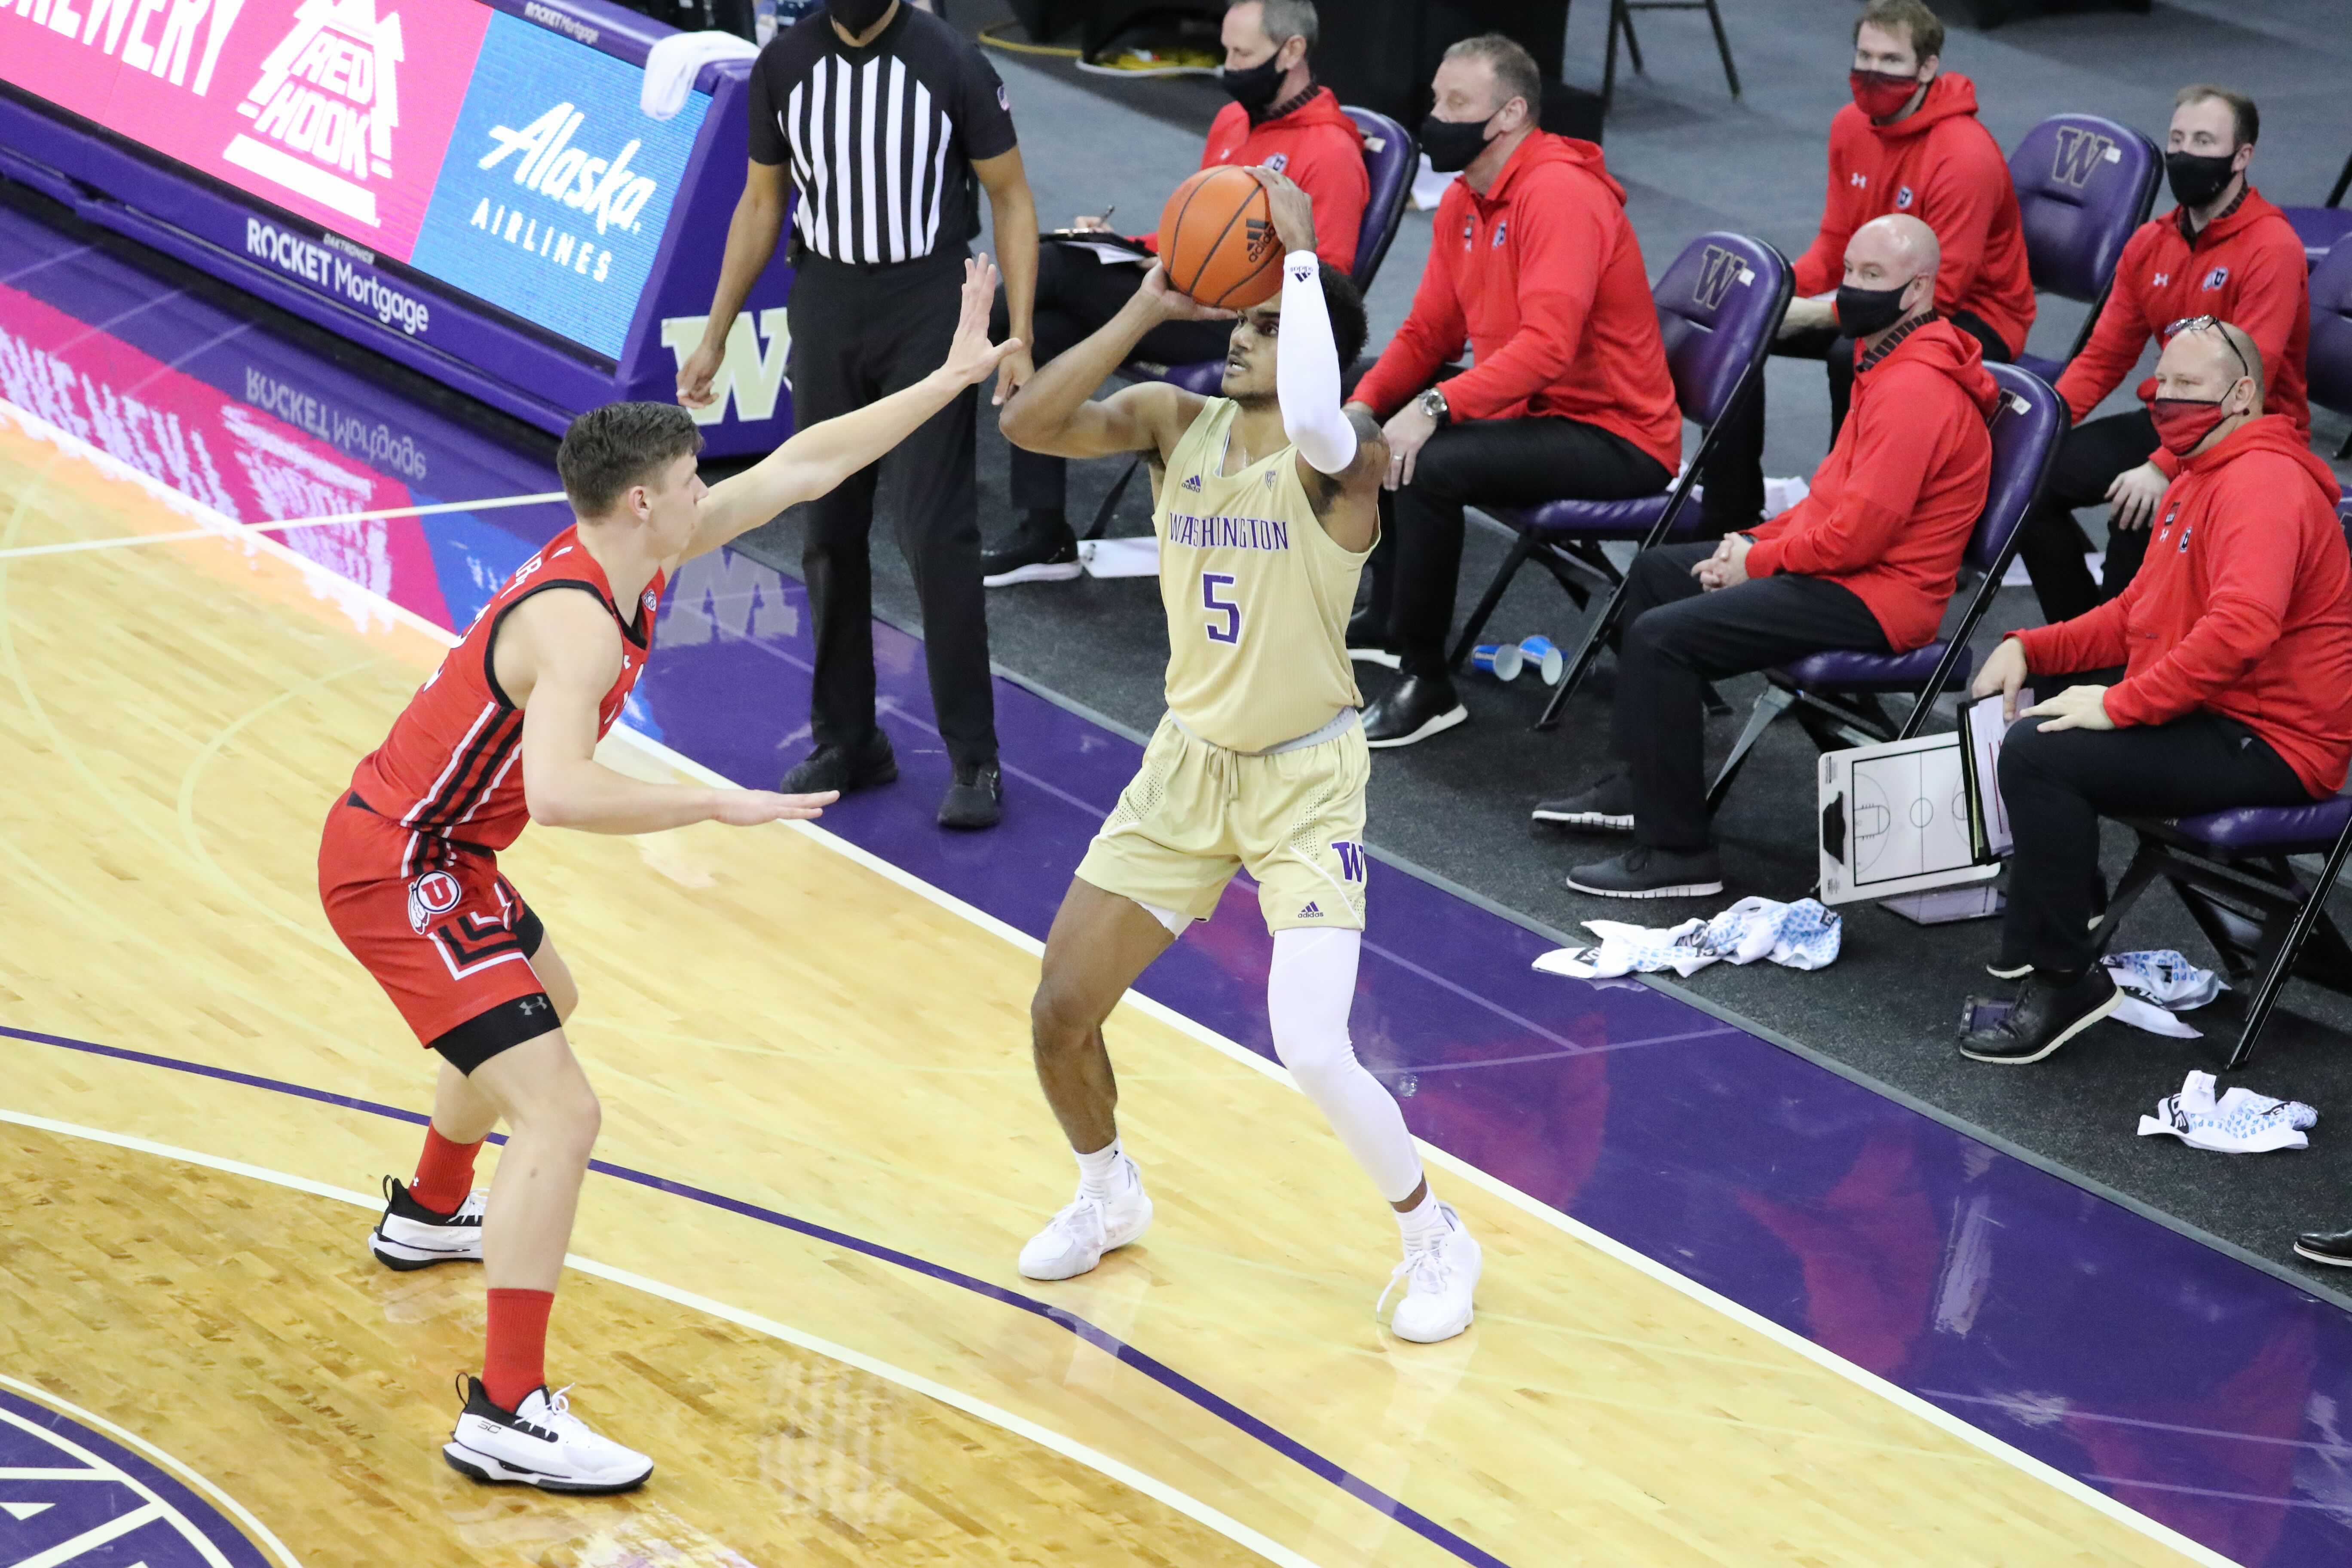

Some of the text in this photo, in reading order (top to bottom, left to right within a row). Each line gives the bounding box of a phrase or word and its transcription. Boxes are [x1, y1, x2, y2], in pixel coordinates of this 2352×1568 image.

[291, 31, 374, 105] RED
[254, 80, 371, 180] HOOK
[2052, 126, 2113, 188] W
[478, 102, 657, 234] Alaska
[324, 233, 375, 265] DAKTRONICS
[471, 197, 612, 282] AIRLINES
[1249, 226, 1277, 263] adida
[247, 217, 429, 335] ROCKET Mortgage
[1693, 245, 1747, 310] W
[1181, 481, 1200, 493] adida
[1169, 511, 1289, 551] WASHINGTON
[1201, 571, 1242, 644] 5
[420, 877, 450, 908] U
[1330, 840, 1364, 883] W
